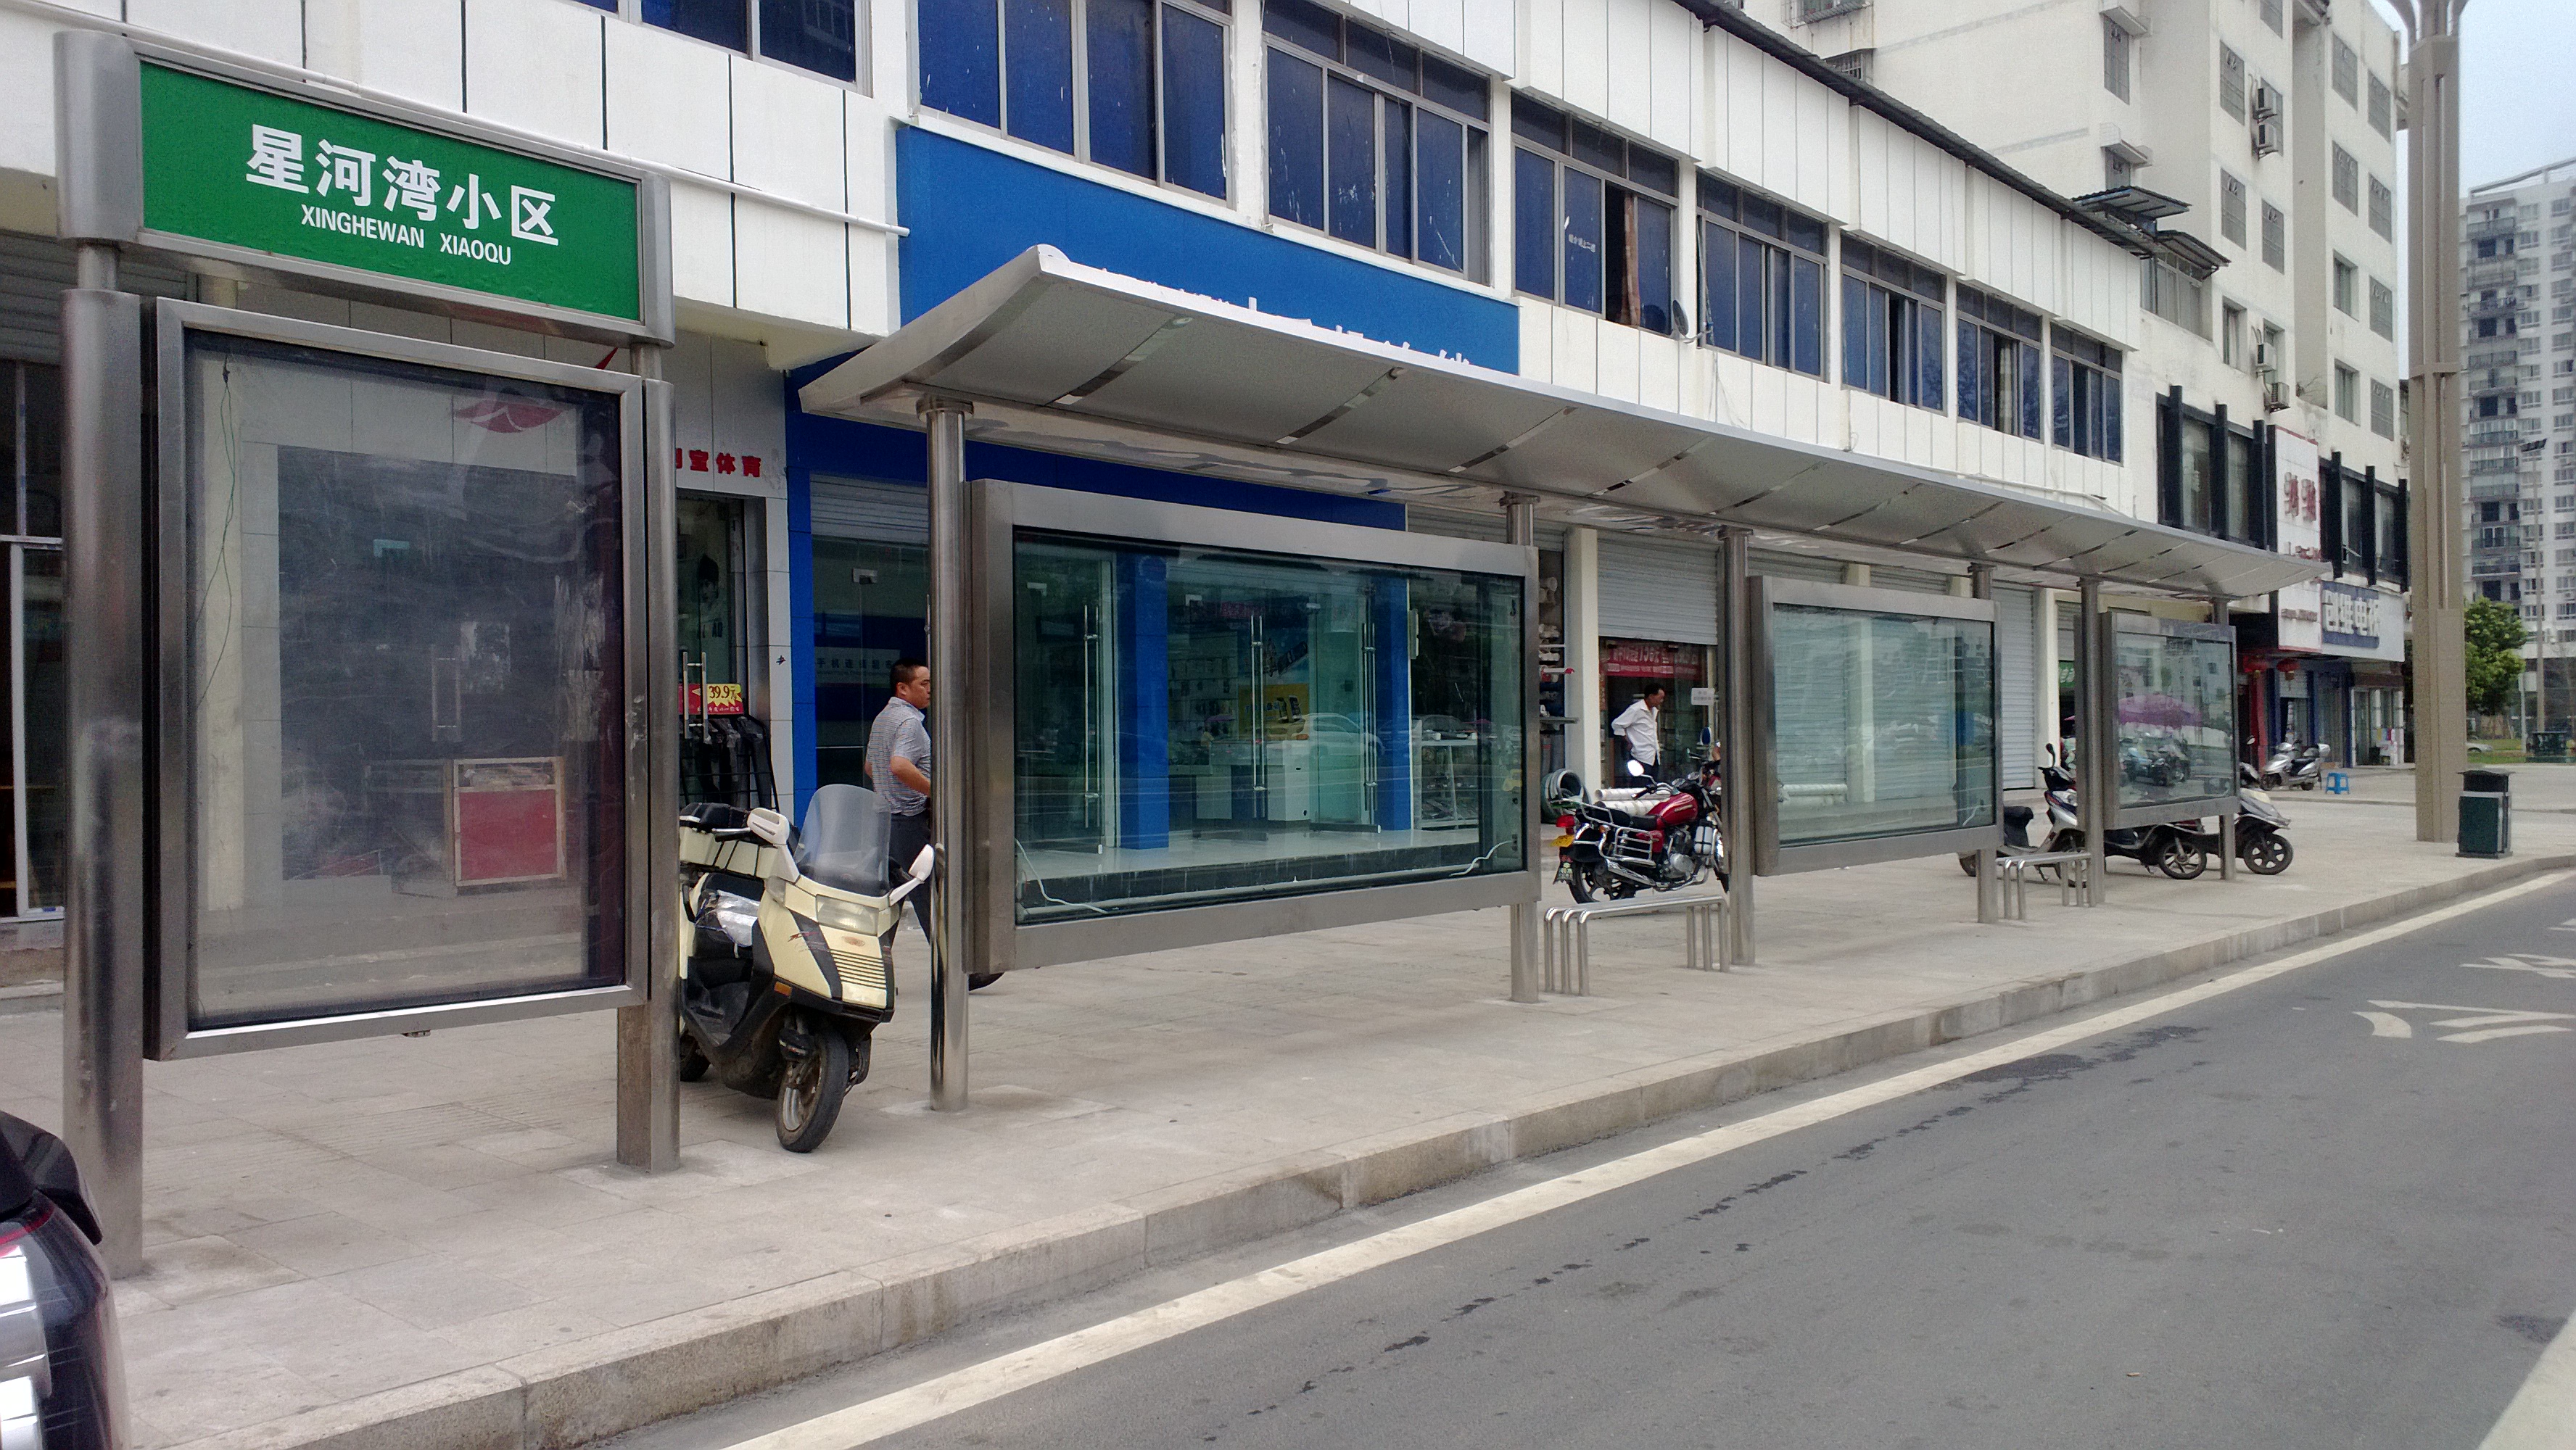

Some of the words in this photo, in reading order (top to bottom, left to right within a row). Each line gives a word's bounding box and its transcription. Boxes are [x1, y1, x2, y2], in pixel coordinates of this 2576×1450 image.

[246, 123, 559, 246] 星河湾小区
[301, 204, 424, 248] XINGHEWAN
[439, 232, 511, 265] XIAOQU
[675, 447, 761, 478] 宝体育
